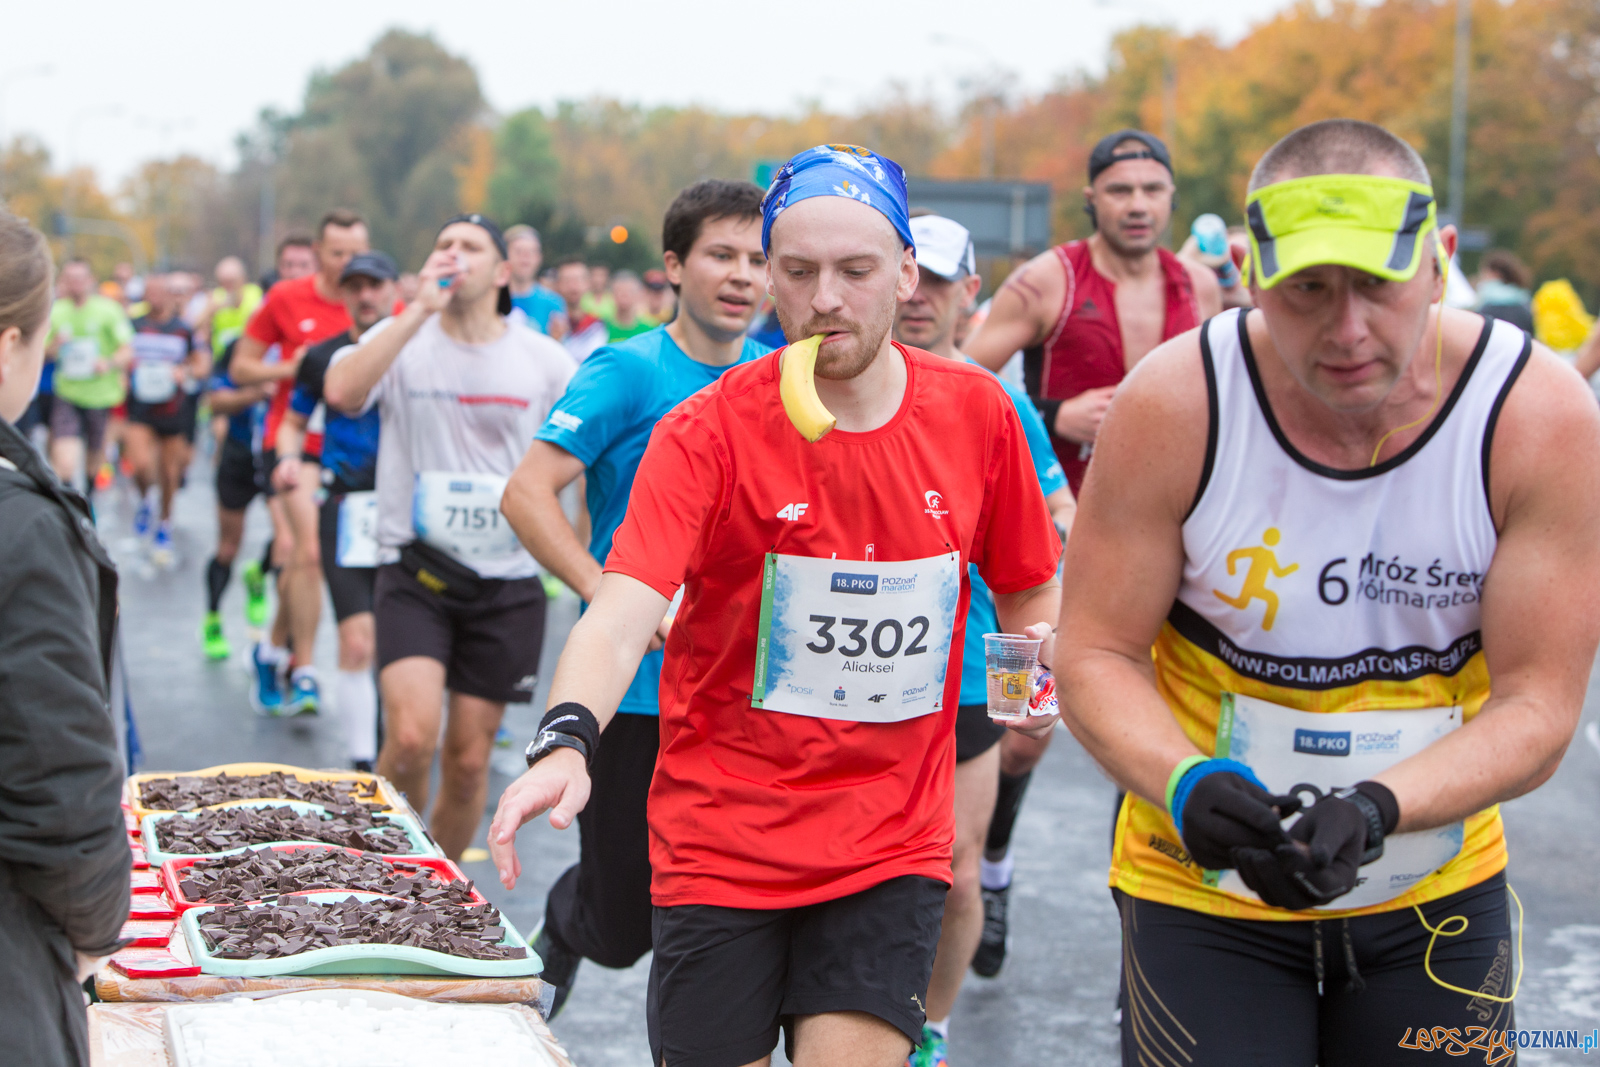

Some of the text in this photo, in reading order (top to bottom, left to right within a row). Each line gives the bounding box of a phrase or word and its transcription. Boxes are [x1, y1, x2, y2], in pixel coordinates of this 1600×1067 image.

[444, 505, 498, 529] 7151
[776, 503, 809, 521] 4F
[836, 578, 874, 590] 18. PKO
[881, 583, 915, 592] maraton
[1317, 558, 1349, 606] 6
[1356, 578, 1482, 609] ółmarato
[805, 614, 930, 659] 3302
[841, 660, 895, 673] Aliaksei
[867, 693, 887, 703] 4F
[1299, 735, 1347, 750] 18. PKO
